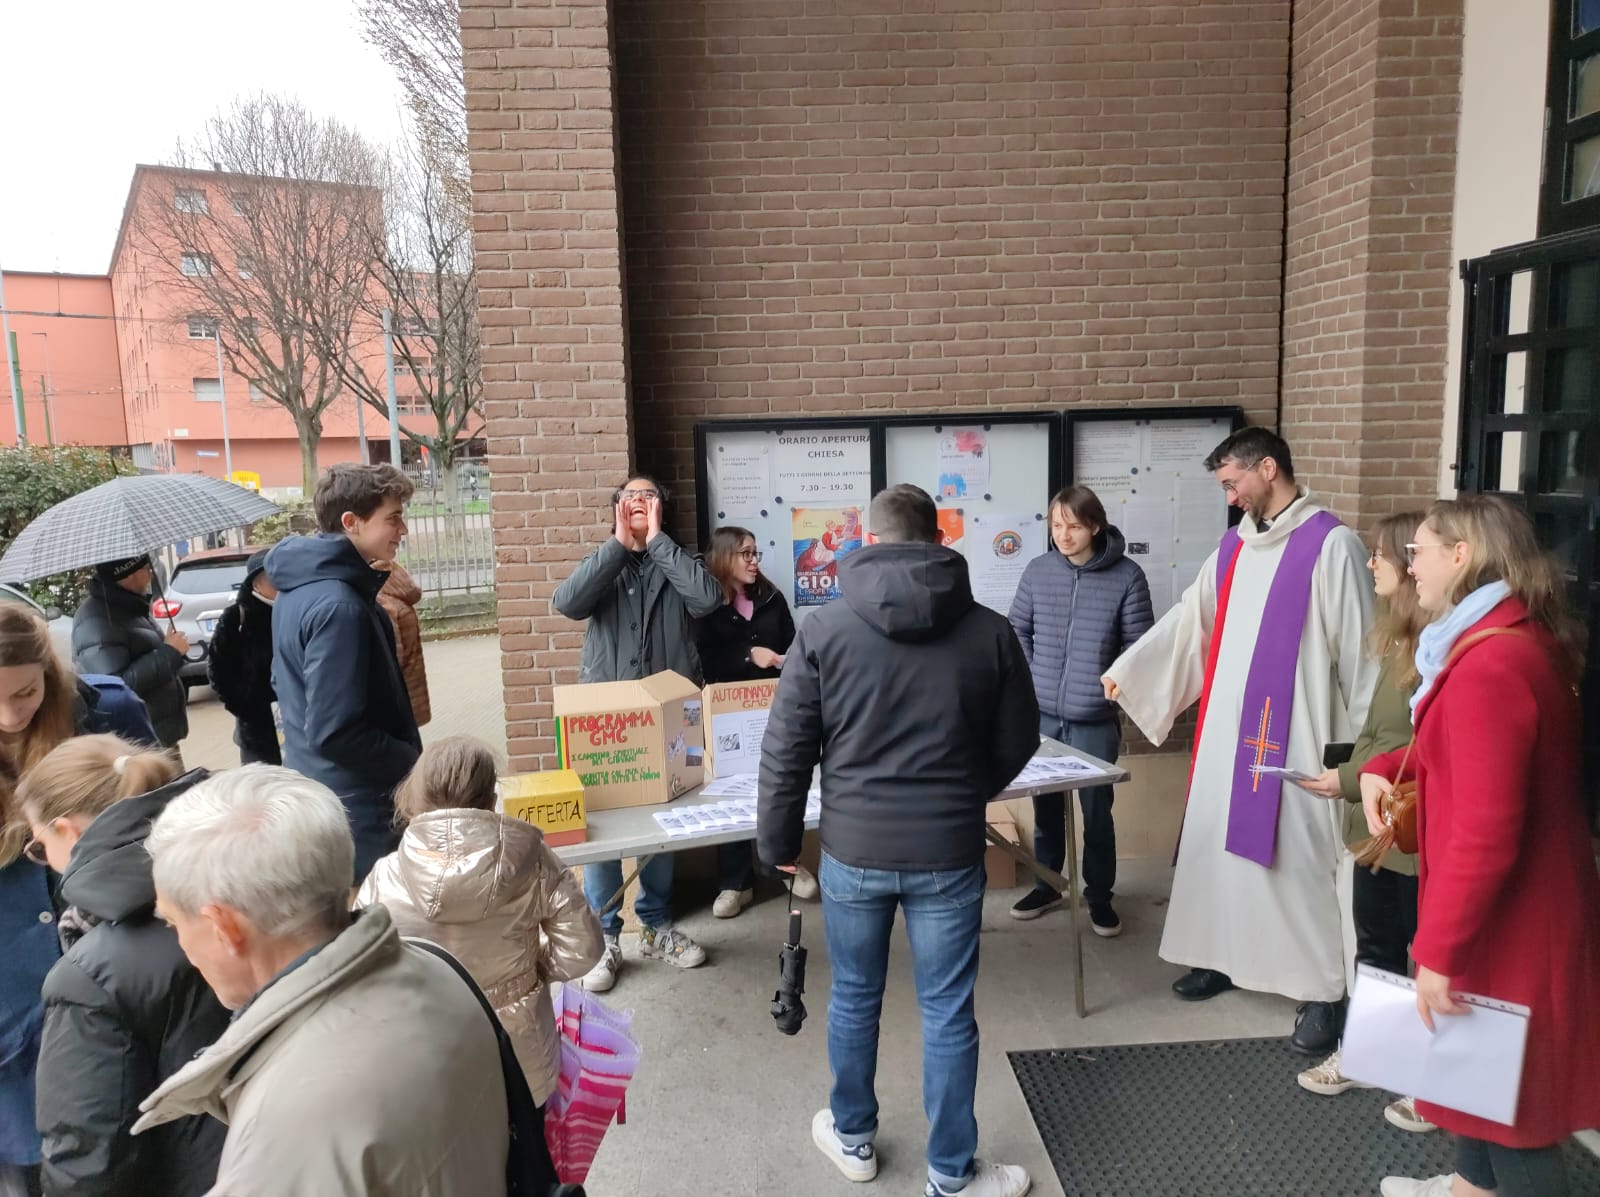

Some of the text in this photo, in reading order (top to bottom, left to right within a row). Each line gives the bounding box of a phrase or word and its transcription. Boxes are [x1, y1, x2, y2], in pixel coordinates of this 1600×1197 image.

[778, 435, 818, 445] ORARIO
[808, 450, 845, 459] CHIESA
[800, 483, 819, 492] 7.30
[830, 483, 854, 491] 19.30
[712, 683, 777, 703] AUTOFINANZIA
[569, 710, 655, 734] PROGRAMMA
[589, 729, 628, 746] GMG
[517, 799, 582, 825] OFFERTA
